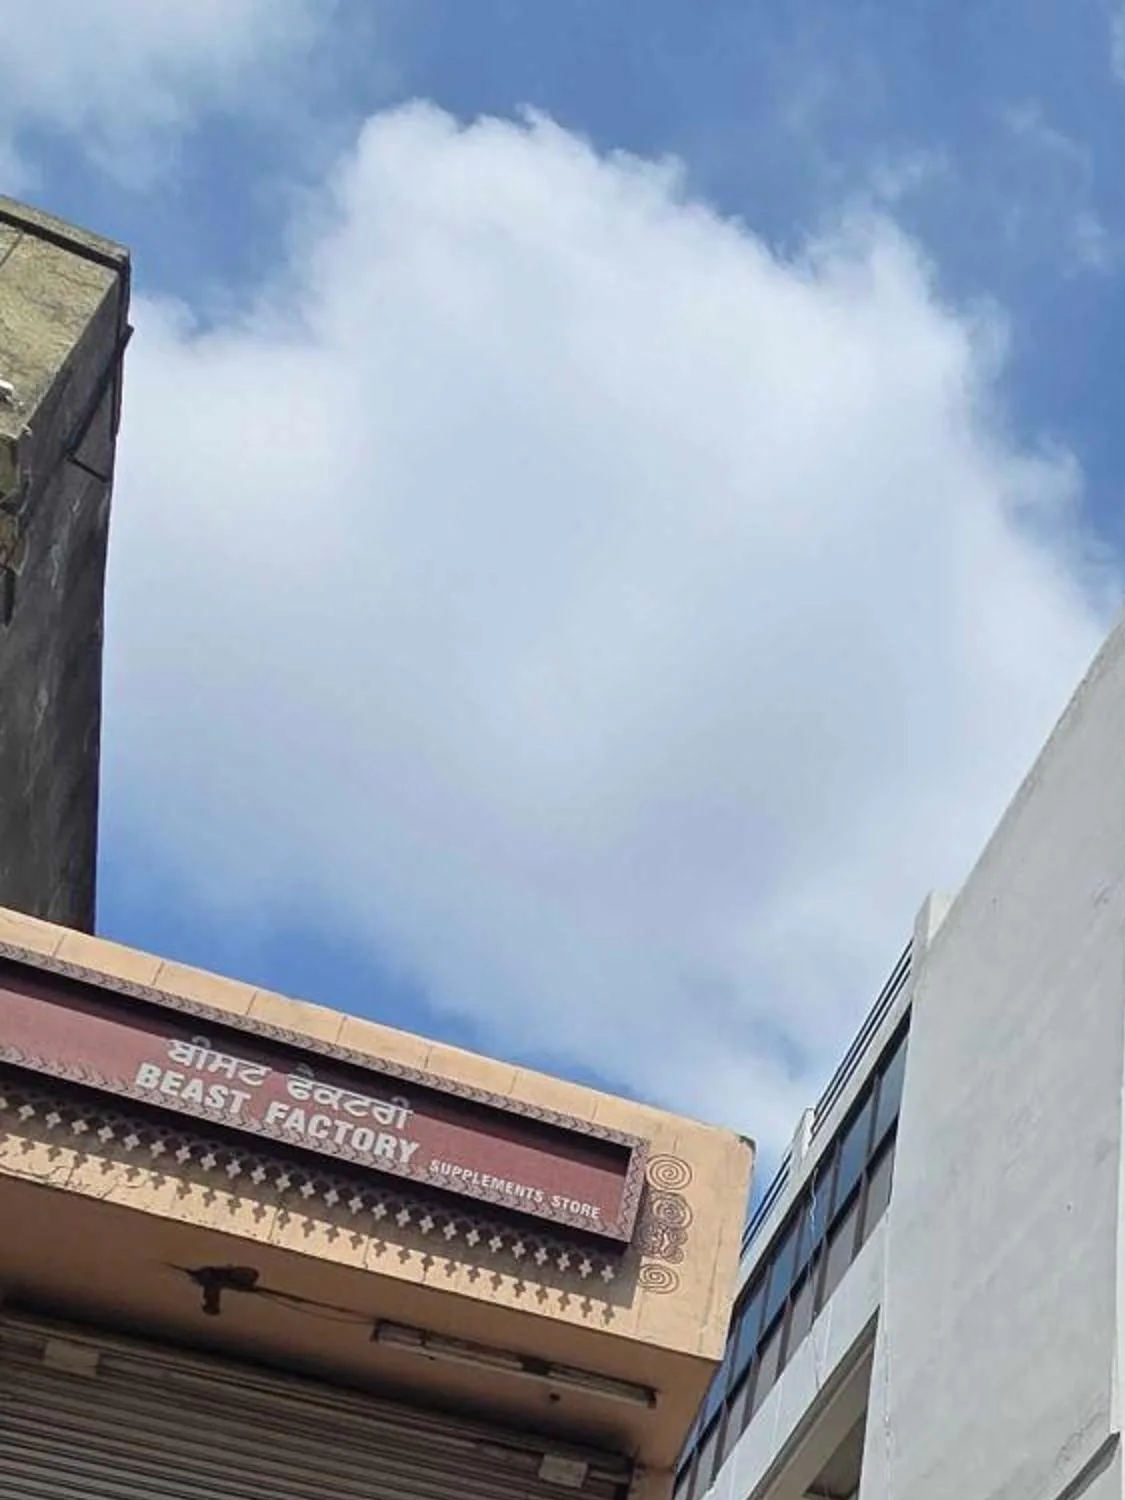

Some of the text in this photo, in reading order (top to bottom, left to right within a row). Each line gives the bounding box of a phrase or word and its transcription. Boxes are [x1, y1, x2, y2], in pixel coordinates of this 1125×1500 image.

[135, 1063, 421, 1164] BEAST FACTORY
[430, 1159, 601, 1220] SUPPLEMENTS STORE
